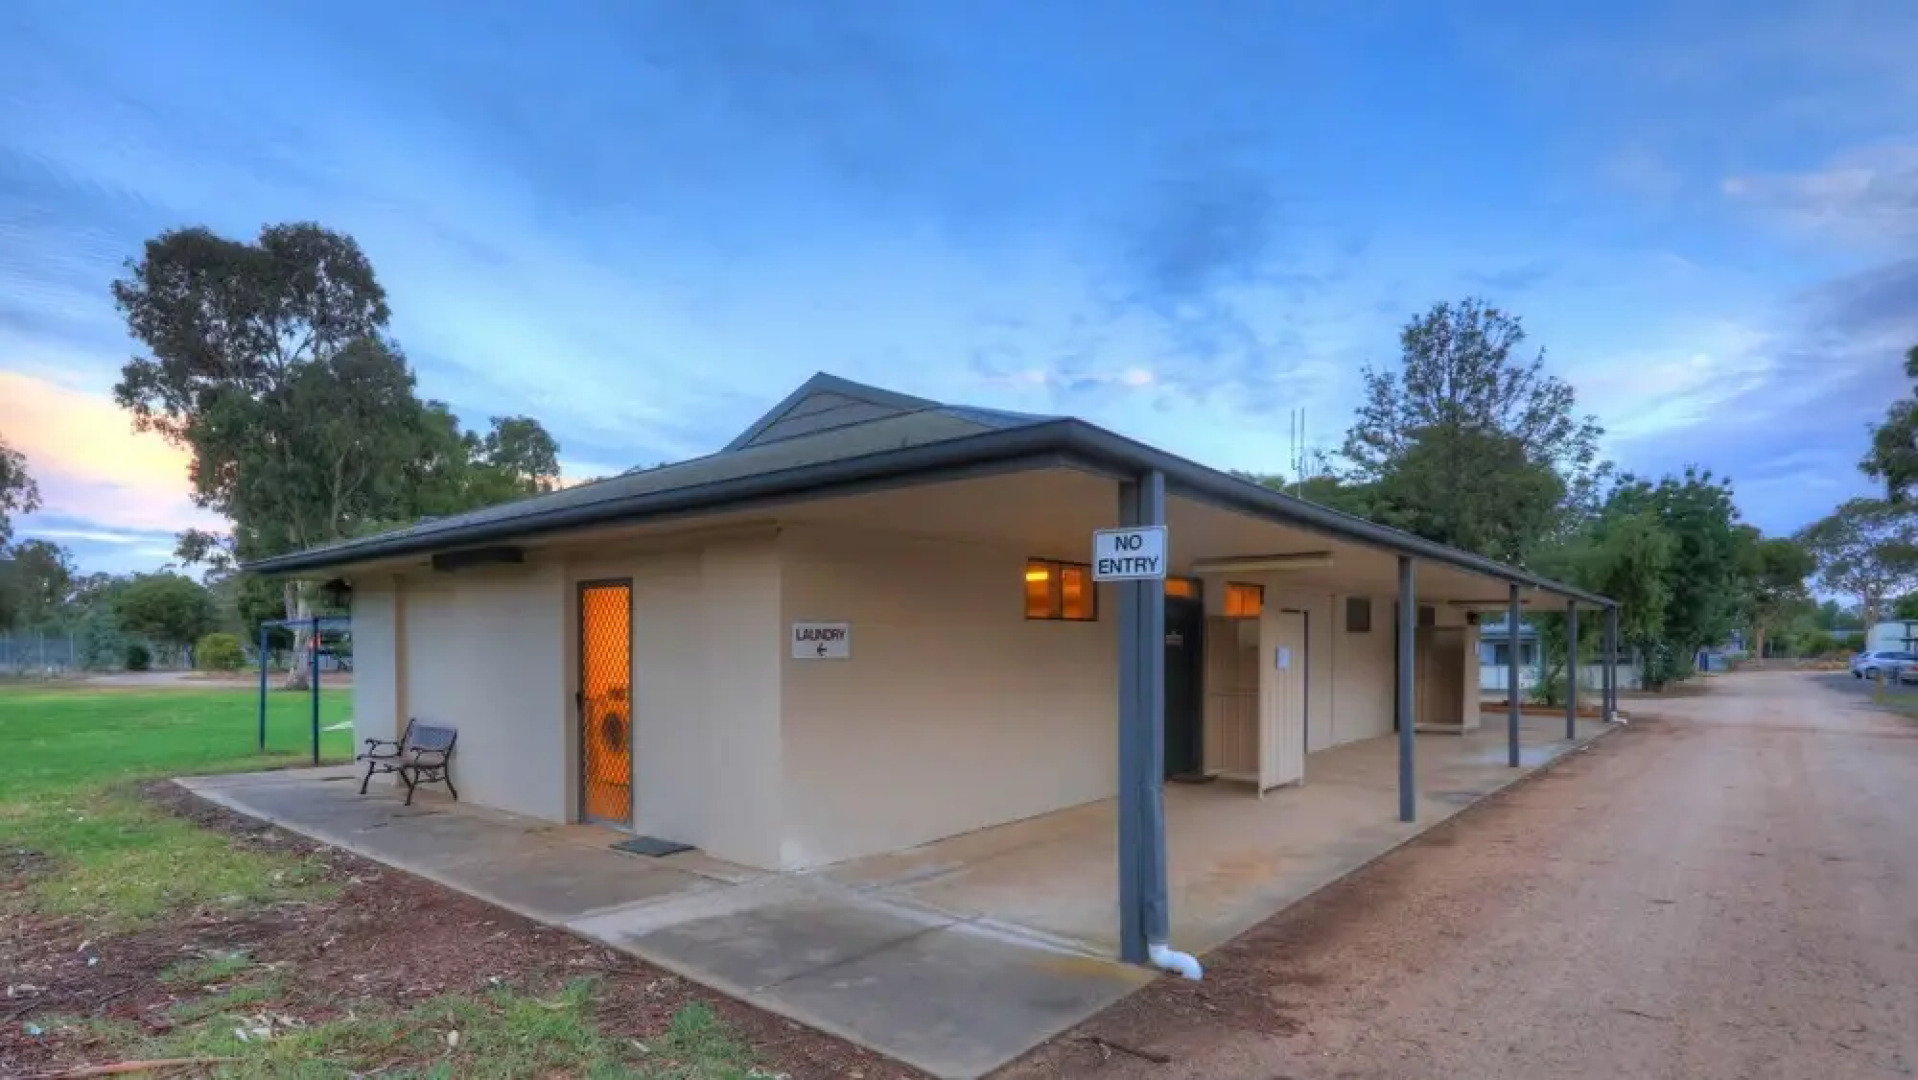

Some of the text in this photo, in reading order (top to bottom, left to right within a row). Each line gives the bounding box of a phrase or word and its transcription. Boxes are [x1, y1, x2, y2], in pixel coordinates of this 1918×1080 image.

[1115, 534, 1142, 551] NO
[1098, 556, 1159, 574] ENTRY
[796, 628, 846, 641] LAUNDRY
